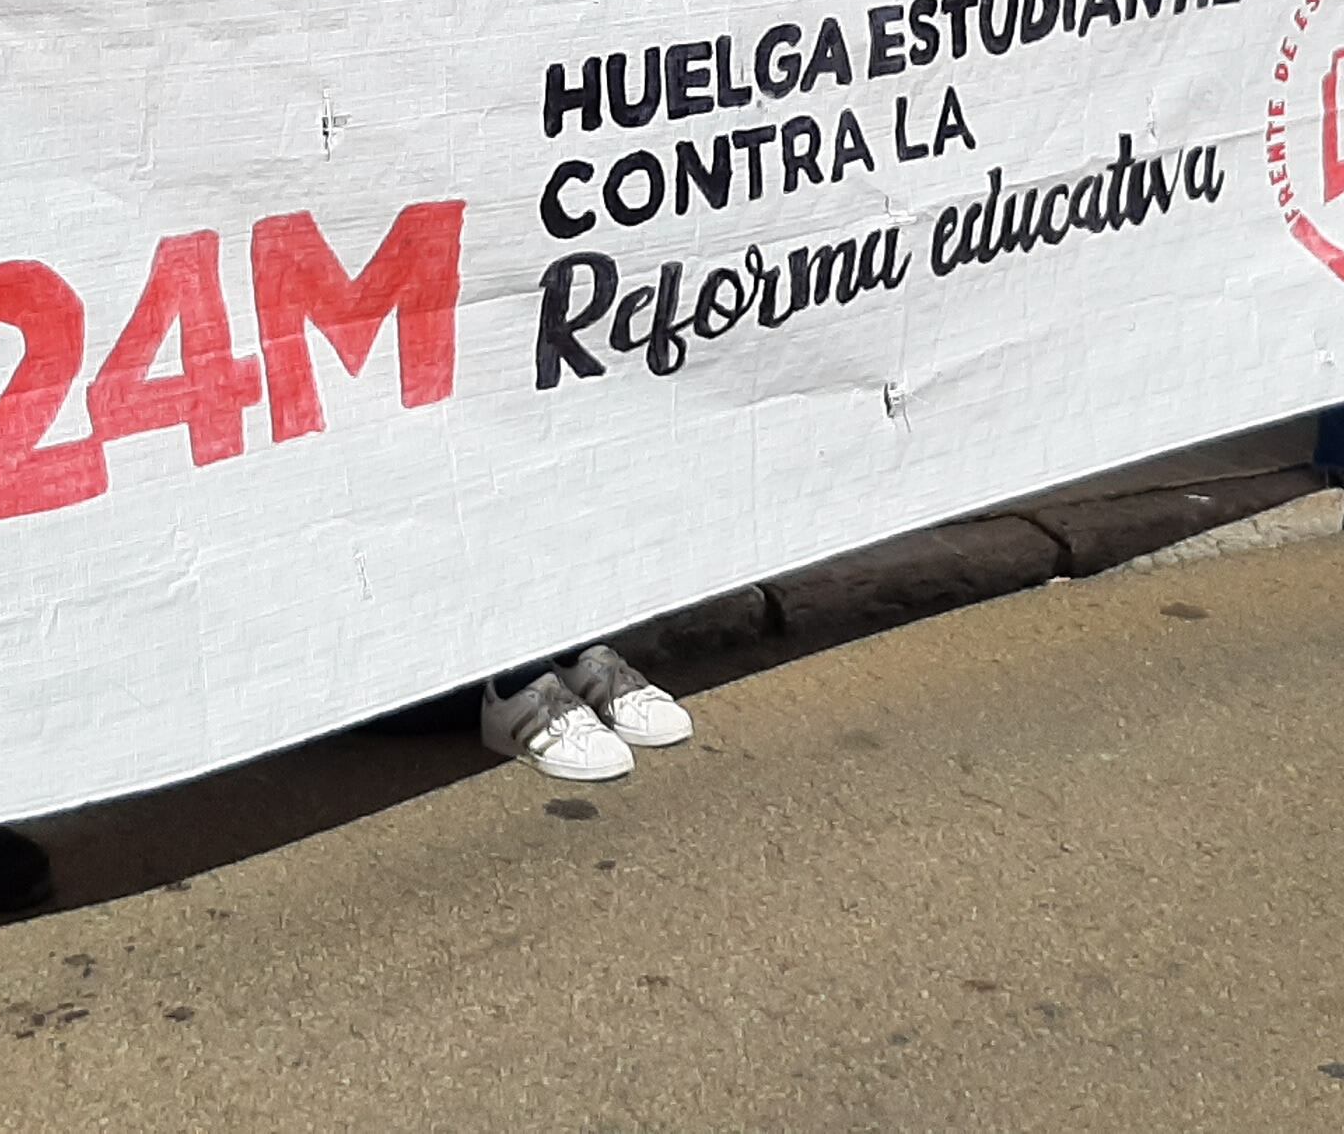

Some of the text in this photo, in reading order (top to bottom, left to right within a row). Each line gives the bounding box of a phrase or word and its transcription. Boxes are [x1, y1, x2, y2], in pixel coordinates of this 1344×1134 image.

[543, 16, 853, 139] HUELGA
[1274, 35, 1298, 83] DE
[539, 84, 977, 241] CONTRA LA
[1265, 97, 1301, 225] FRENTE
[535, 132, 1226, 390] Reforma educativa
